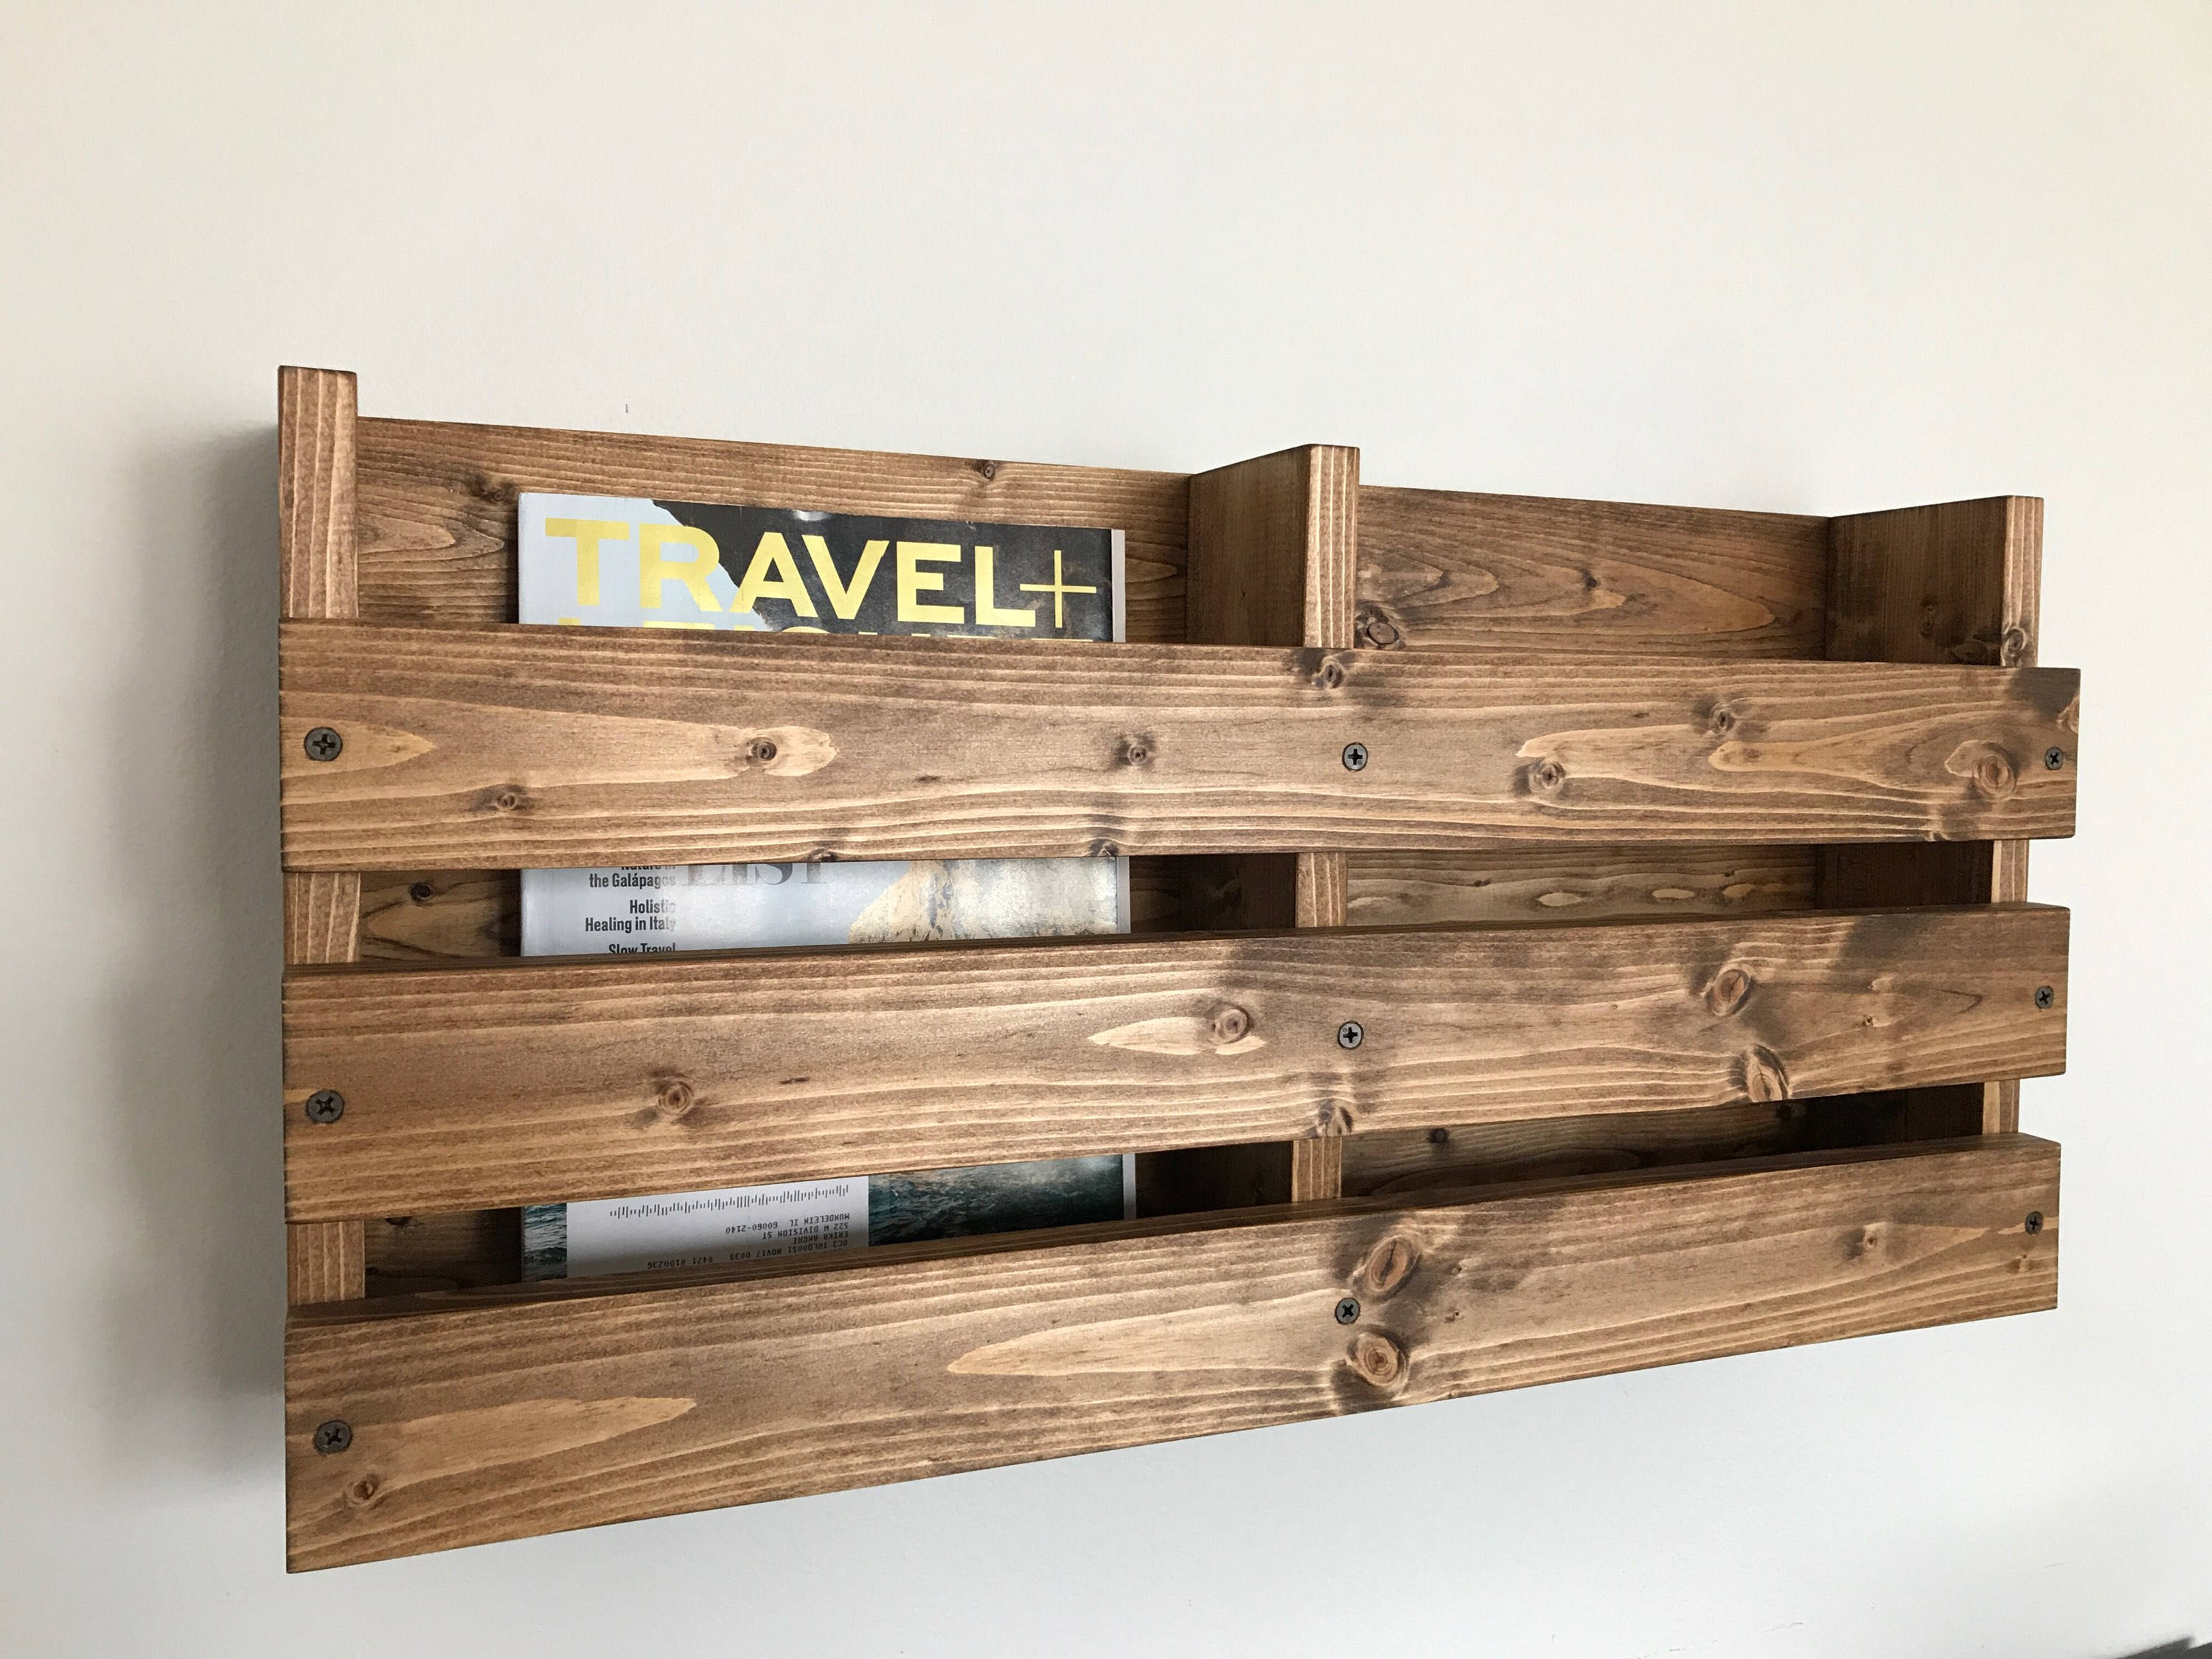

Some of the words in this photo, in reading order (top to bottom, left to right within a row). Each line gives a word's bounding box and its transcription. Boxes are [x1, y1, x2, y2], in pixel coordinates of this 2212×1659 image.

[545, 517, 1096, 628] TRAVEL+
[589, 873, 609, 888] the
[612, 872, 676, 889] Galápagos
[630, 899, 676, 914] Holistic
[585, 917, 632, 933] Healing
[635, 917, 647, 931] in
[650, 916, 676, 932] Italy
[789, 1219, 799, 1227] IL
[804, 1213, 850, 1225] MUNDELEIN
[726, 1221, 778, 1234] 60060-2140
[777, 1225, 819, 1238] DIVISION
[834, 1222, 849, 1231] 522
[762, 1231, 772, 1239] ST
[824, 1231, 849, 1239] ERIKA
